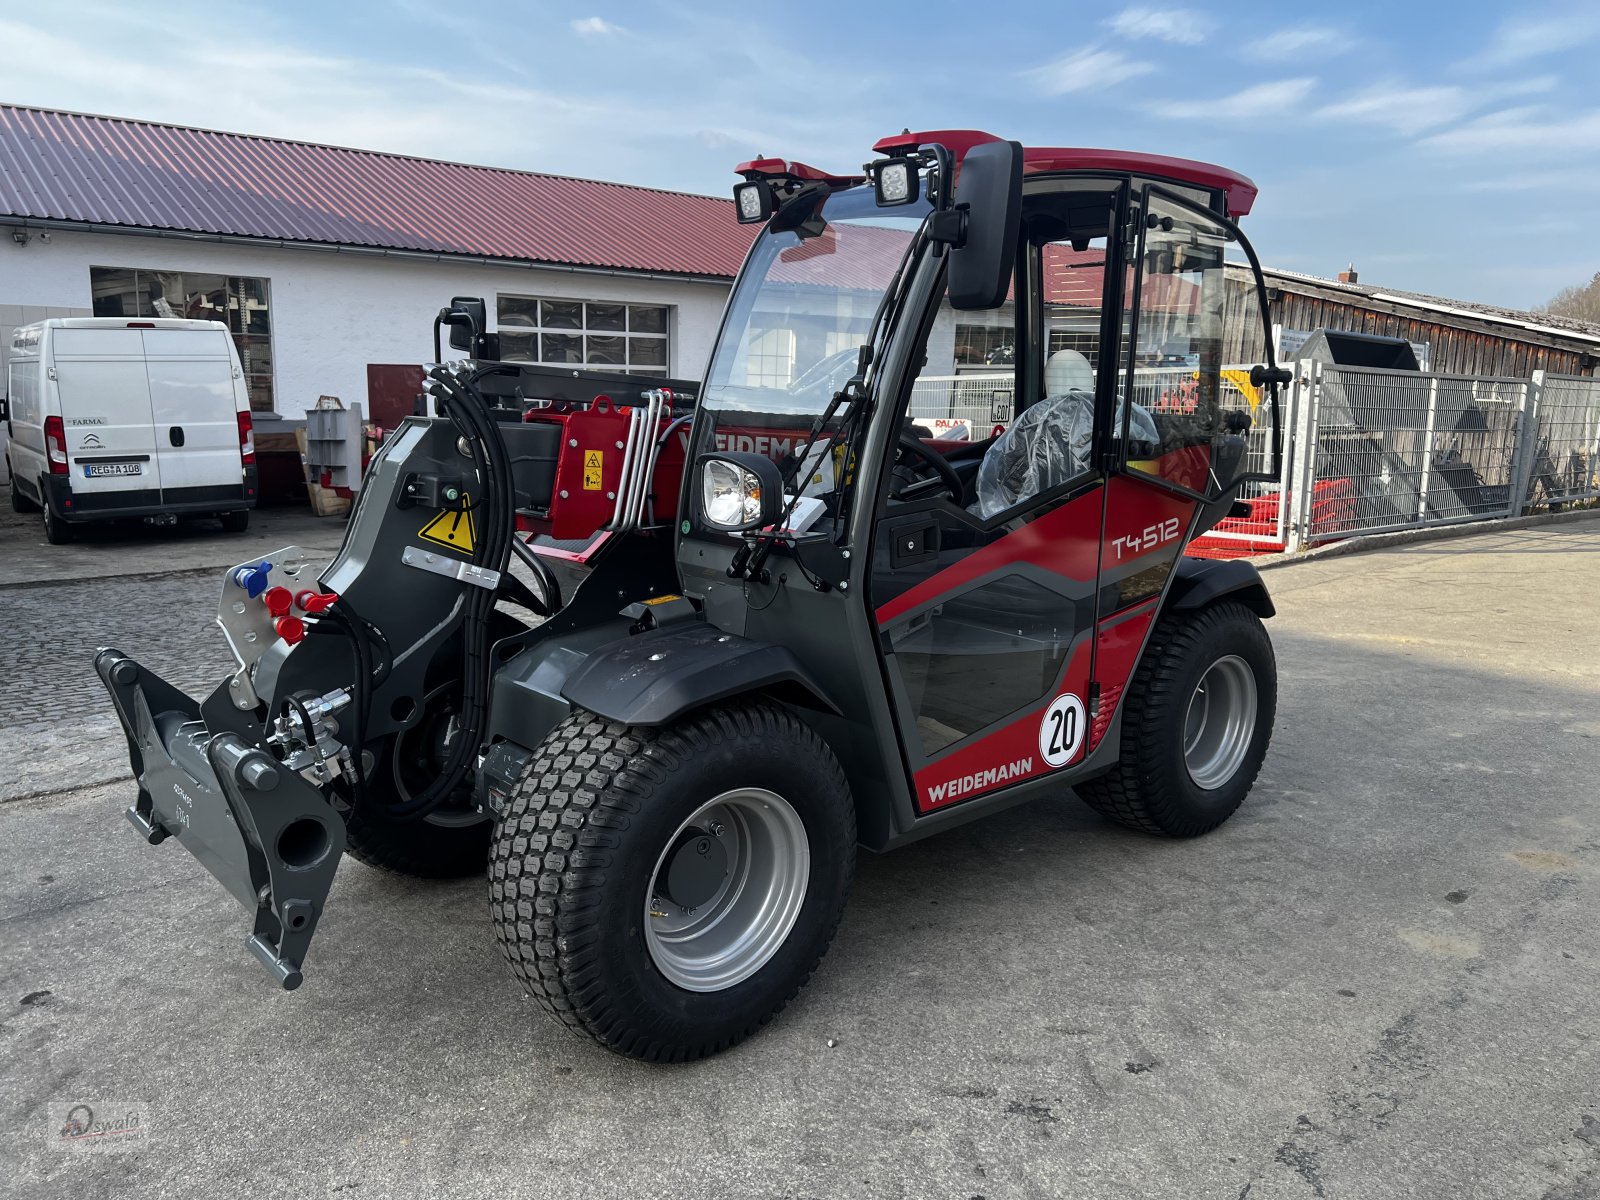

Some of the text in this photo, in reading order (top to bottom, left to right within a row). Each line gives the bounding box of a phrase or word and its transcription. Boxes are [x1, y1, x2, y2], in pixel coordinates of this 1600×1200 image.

[90, 465, 110, 475] REG
[1111, 517, 1180, 560] T4512
[1048, 705, 1077, 757] 20
[927, 756, 1034, 803] WEIDEMANN
